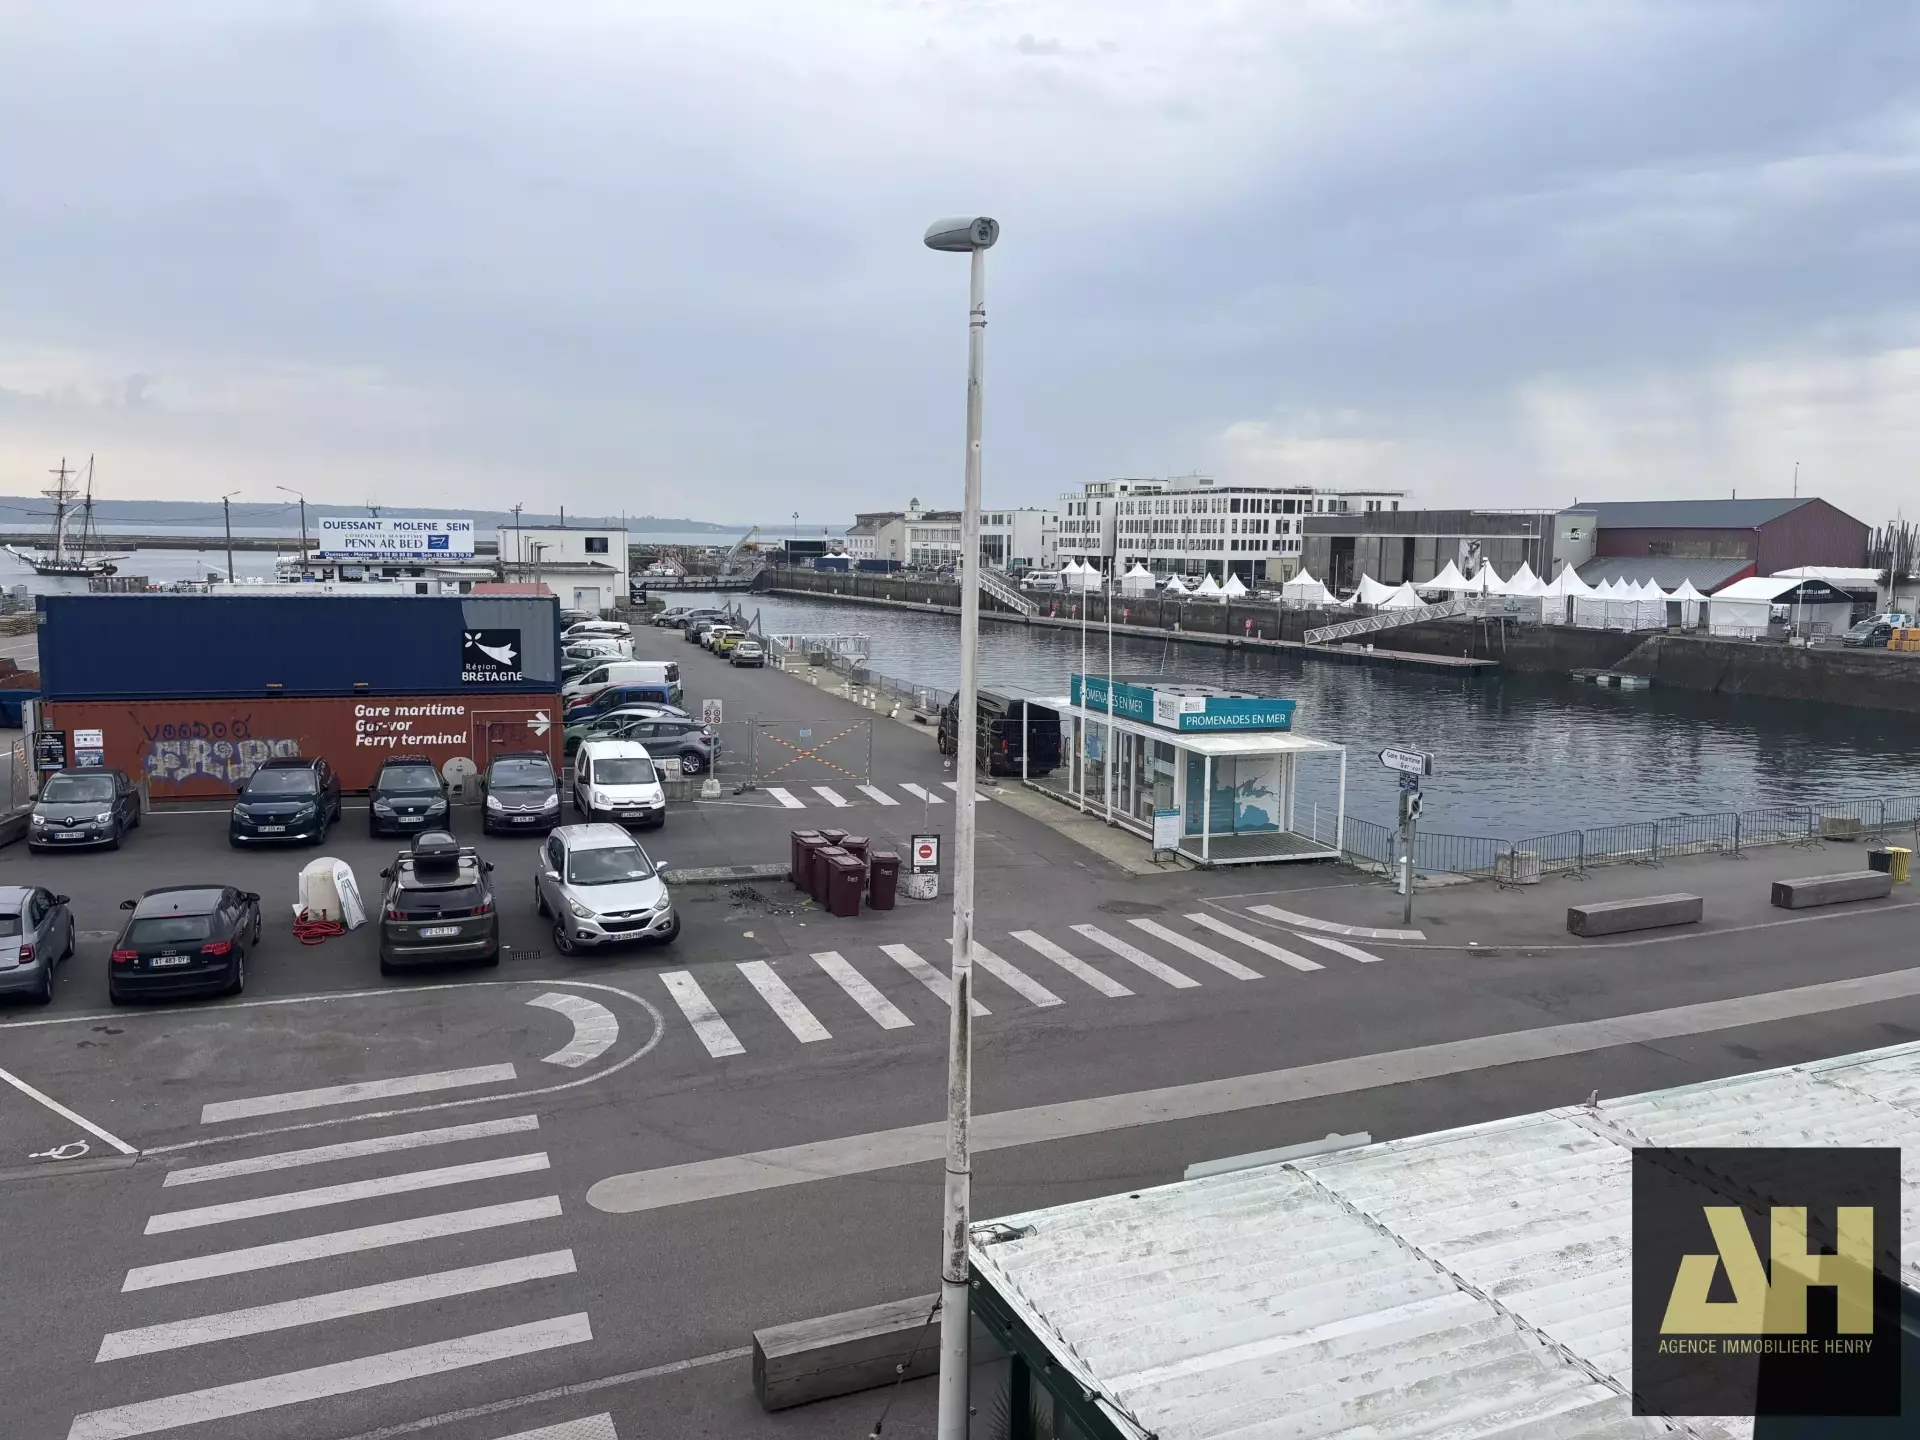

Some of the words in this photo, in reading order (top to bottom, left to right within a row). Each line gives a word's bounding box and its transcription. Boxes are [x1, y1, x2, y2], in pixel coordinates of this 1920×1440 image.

[323, 520, 383, 530] OUESSANT
[393, 521, 438, 531] MOLENE
[446, 522, 470, 531] SEIN
[345, 538, 376, 548] PENN
[379, 539, 396, 549] AR
[400, 539, 423, 549] BED
[465, 663, 497, 672] Région
[462, 671, 523, 682] BRETAGNE
[354, 704, 390, 717] Gare
[394, 703, 465, 716] maritime
[1119, 696, 1128, 710] EN
[1128, 698, 1144, 714] MER
[355, 719, 413, 732] Gar-vor
[1186, 714, 1250, 726] PROMENADES
[1252, 714, 1264, 724] EN
[1266, 713, 1286, 724] MER
[355, 733, 398, 748] Ferry
[401, 731, 467, 745] terminal
